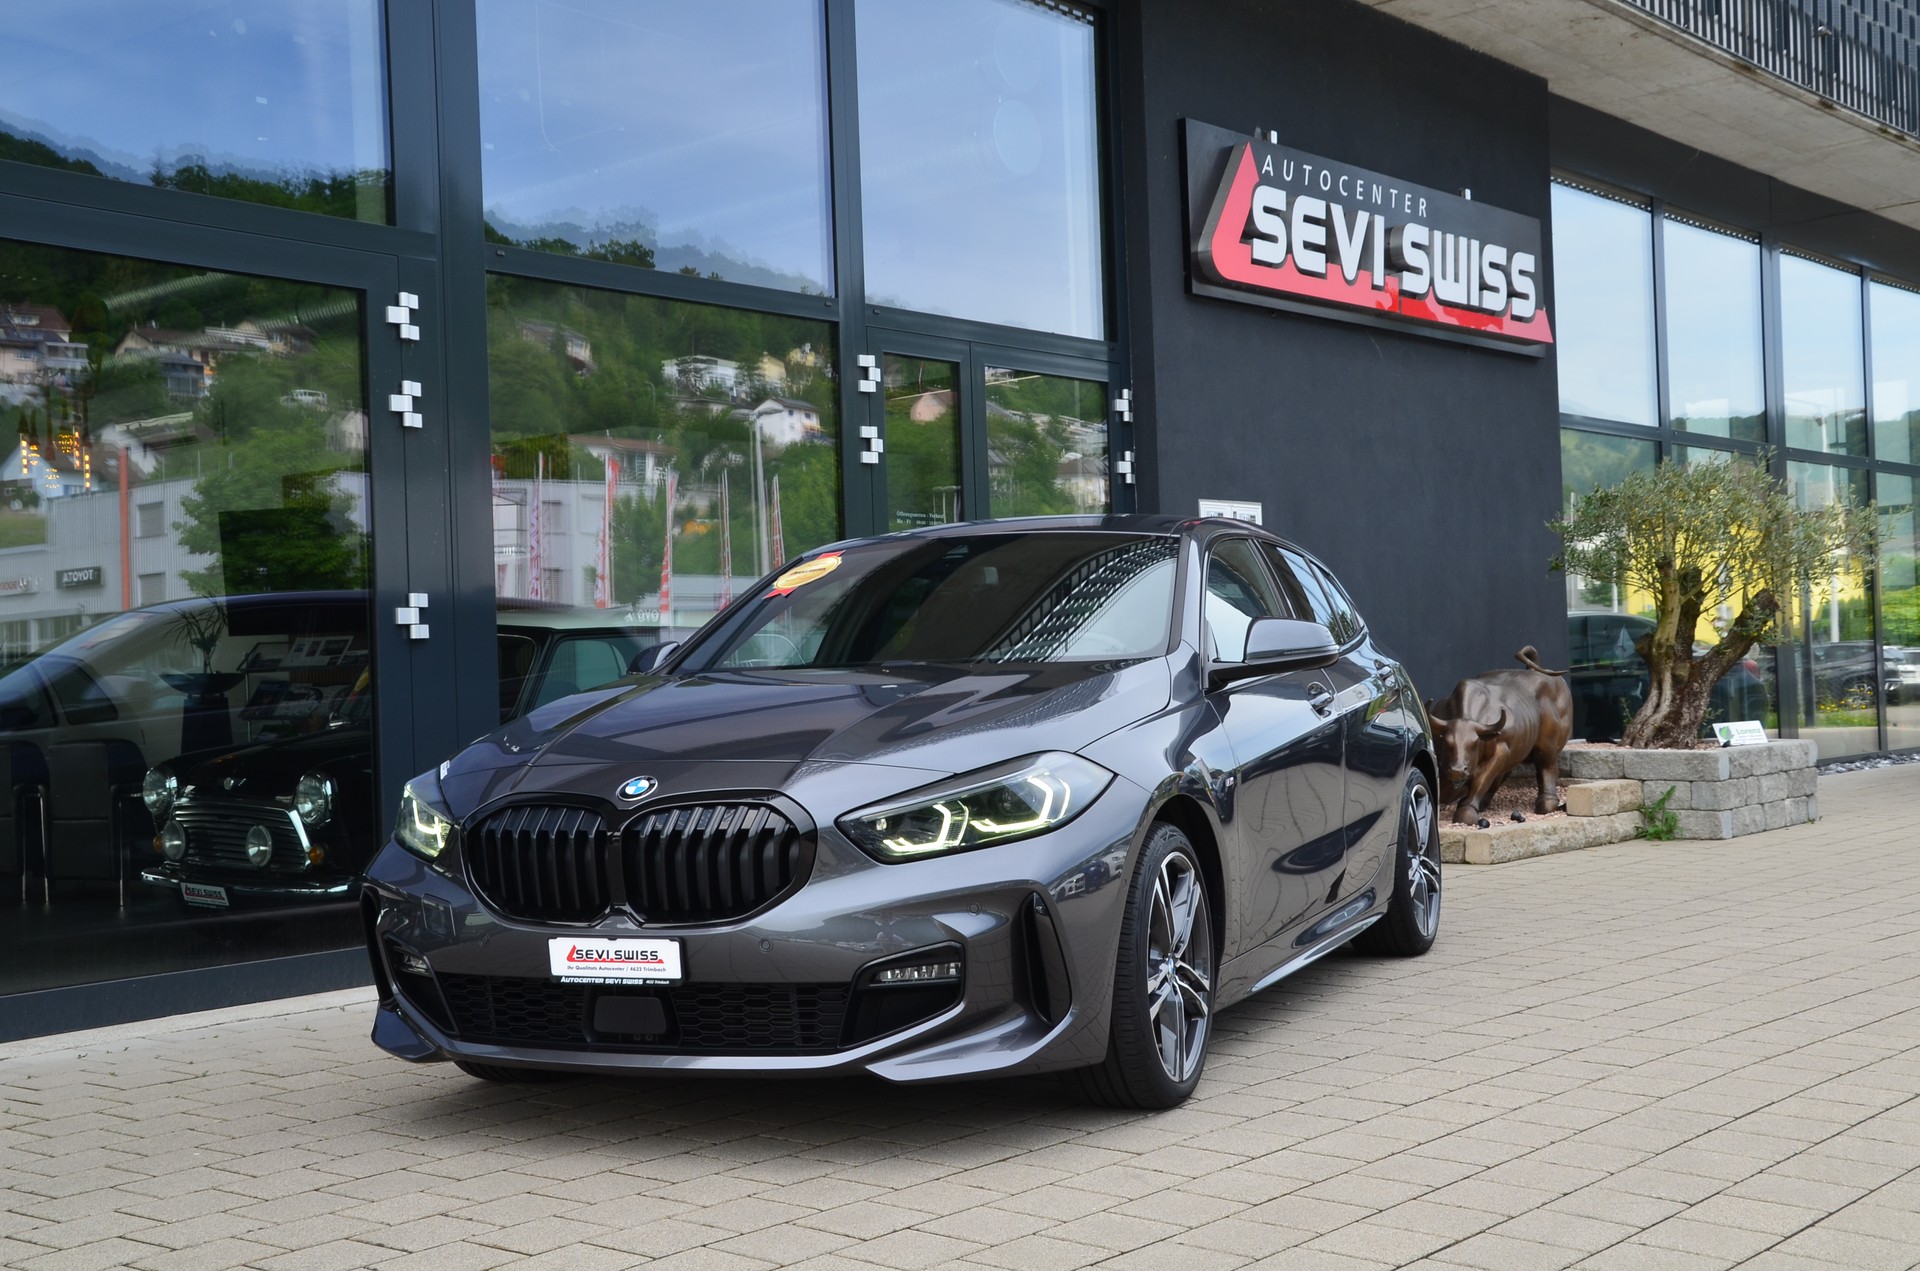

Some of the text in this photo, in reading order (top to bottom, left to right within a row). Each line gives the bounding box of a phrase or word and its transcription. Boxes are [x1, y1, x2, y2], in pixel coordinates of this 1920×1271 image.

[1262, 154, 1427, 218] AUTOCENTER
[1252, 185, 1535, 318] SEVI SWISS
[575, 949, 659, 961] SEVI SWISS
